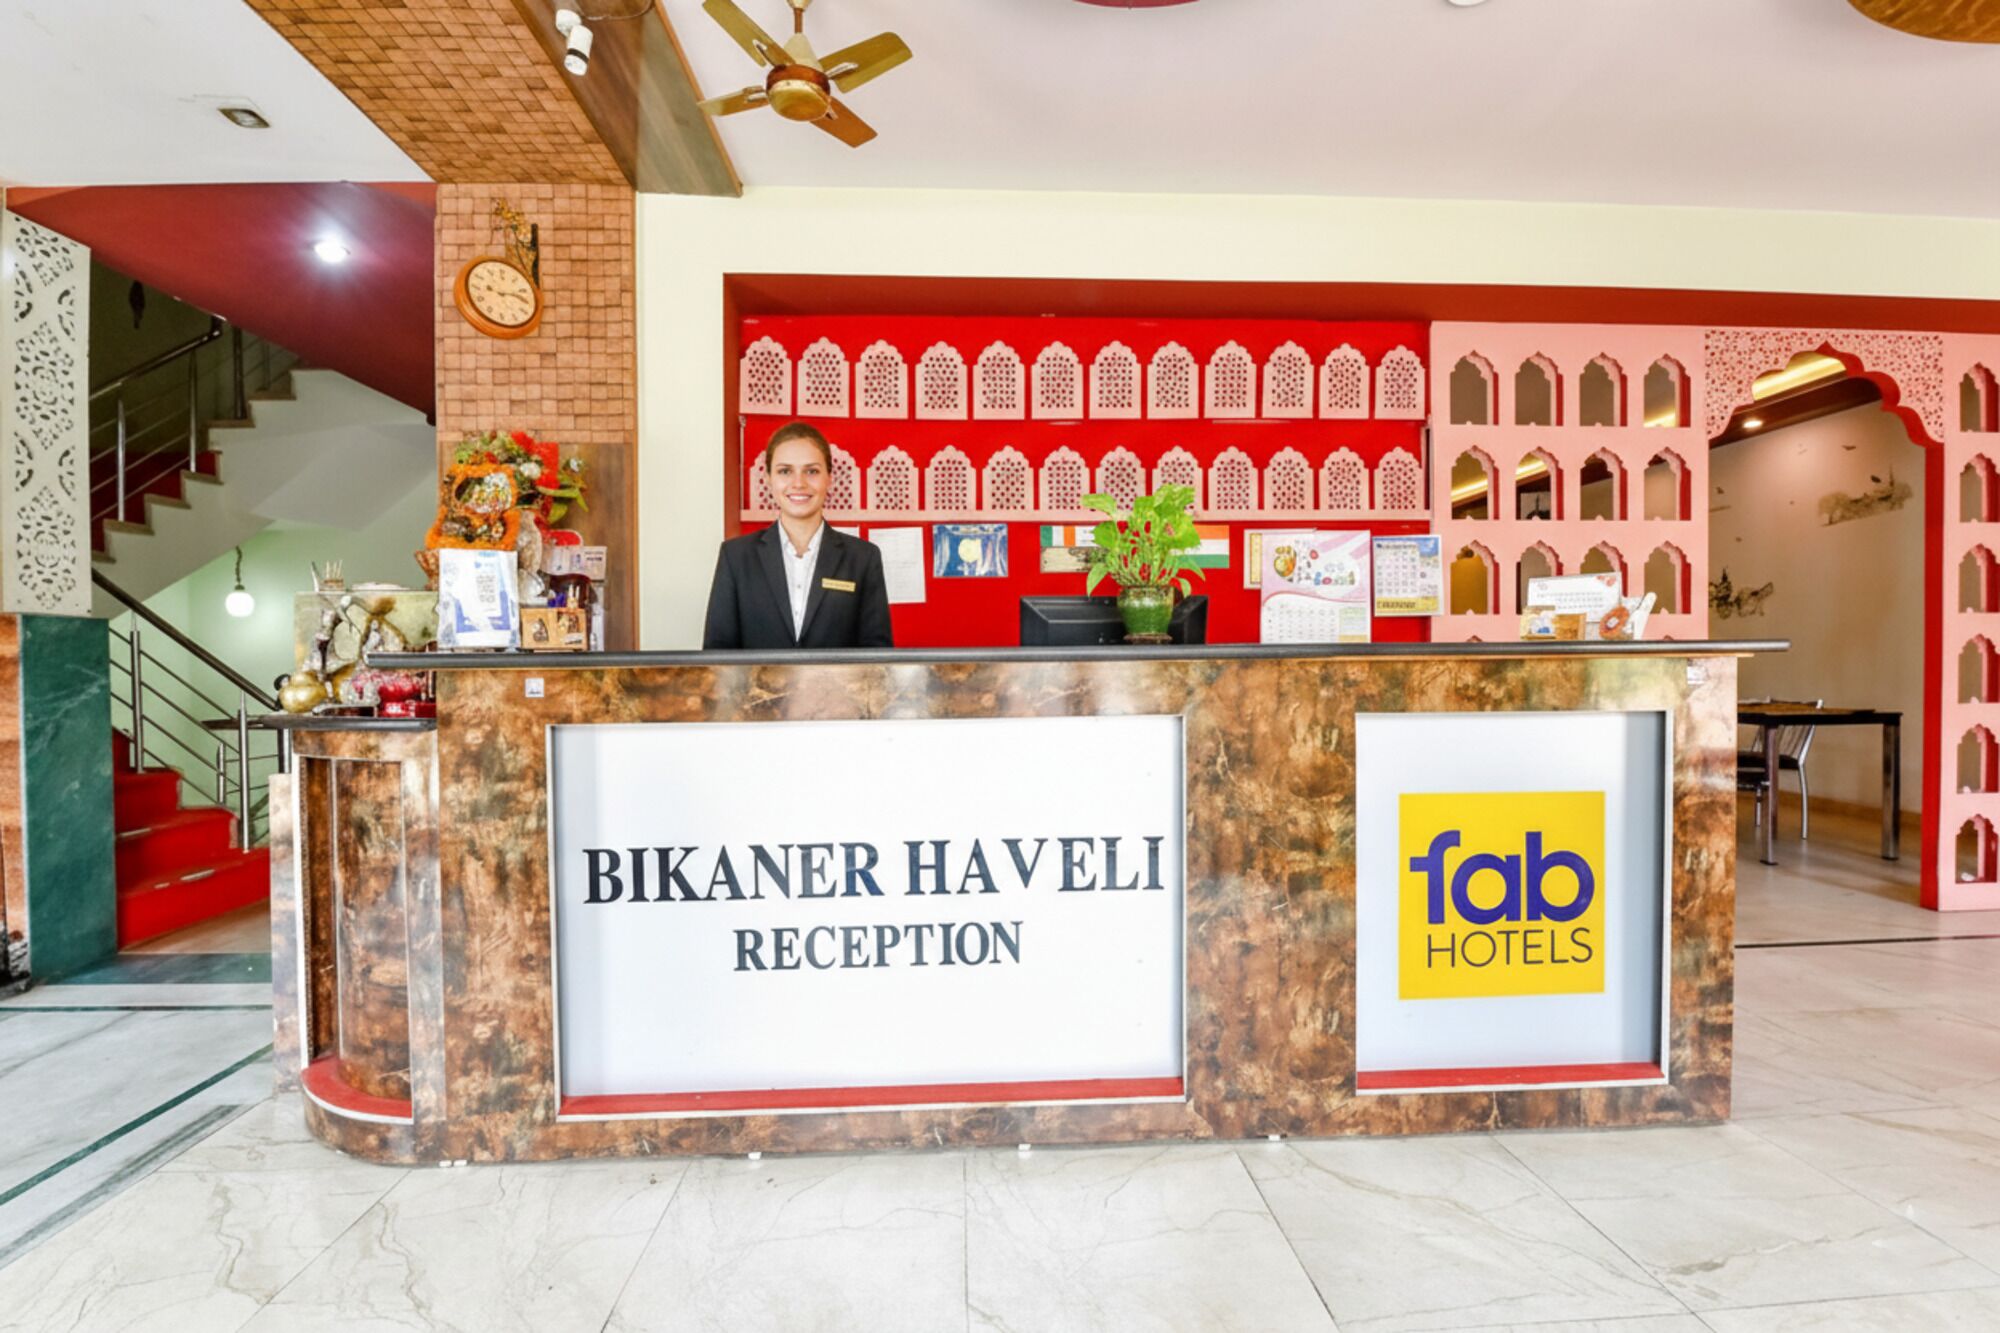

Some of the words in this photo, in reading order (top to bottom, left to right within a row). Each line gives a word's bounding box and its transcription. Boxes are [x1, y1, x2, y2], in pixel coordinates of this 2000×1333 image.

[583, 843, 884, 904] BIKANER
[904, 836, 1165, 895] HAVELI
[1409, 829, 1595, 925] fab
[733, 921, 1023, 971] RECEPTION
[1427, 927, 1593, 968] HOTELS
